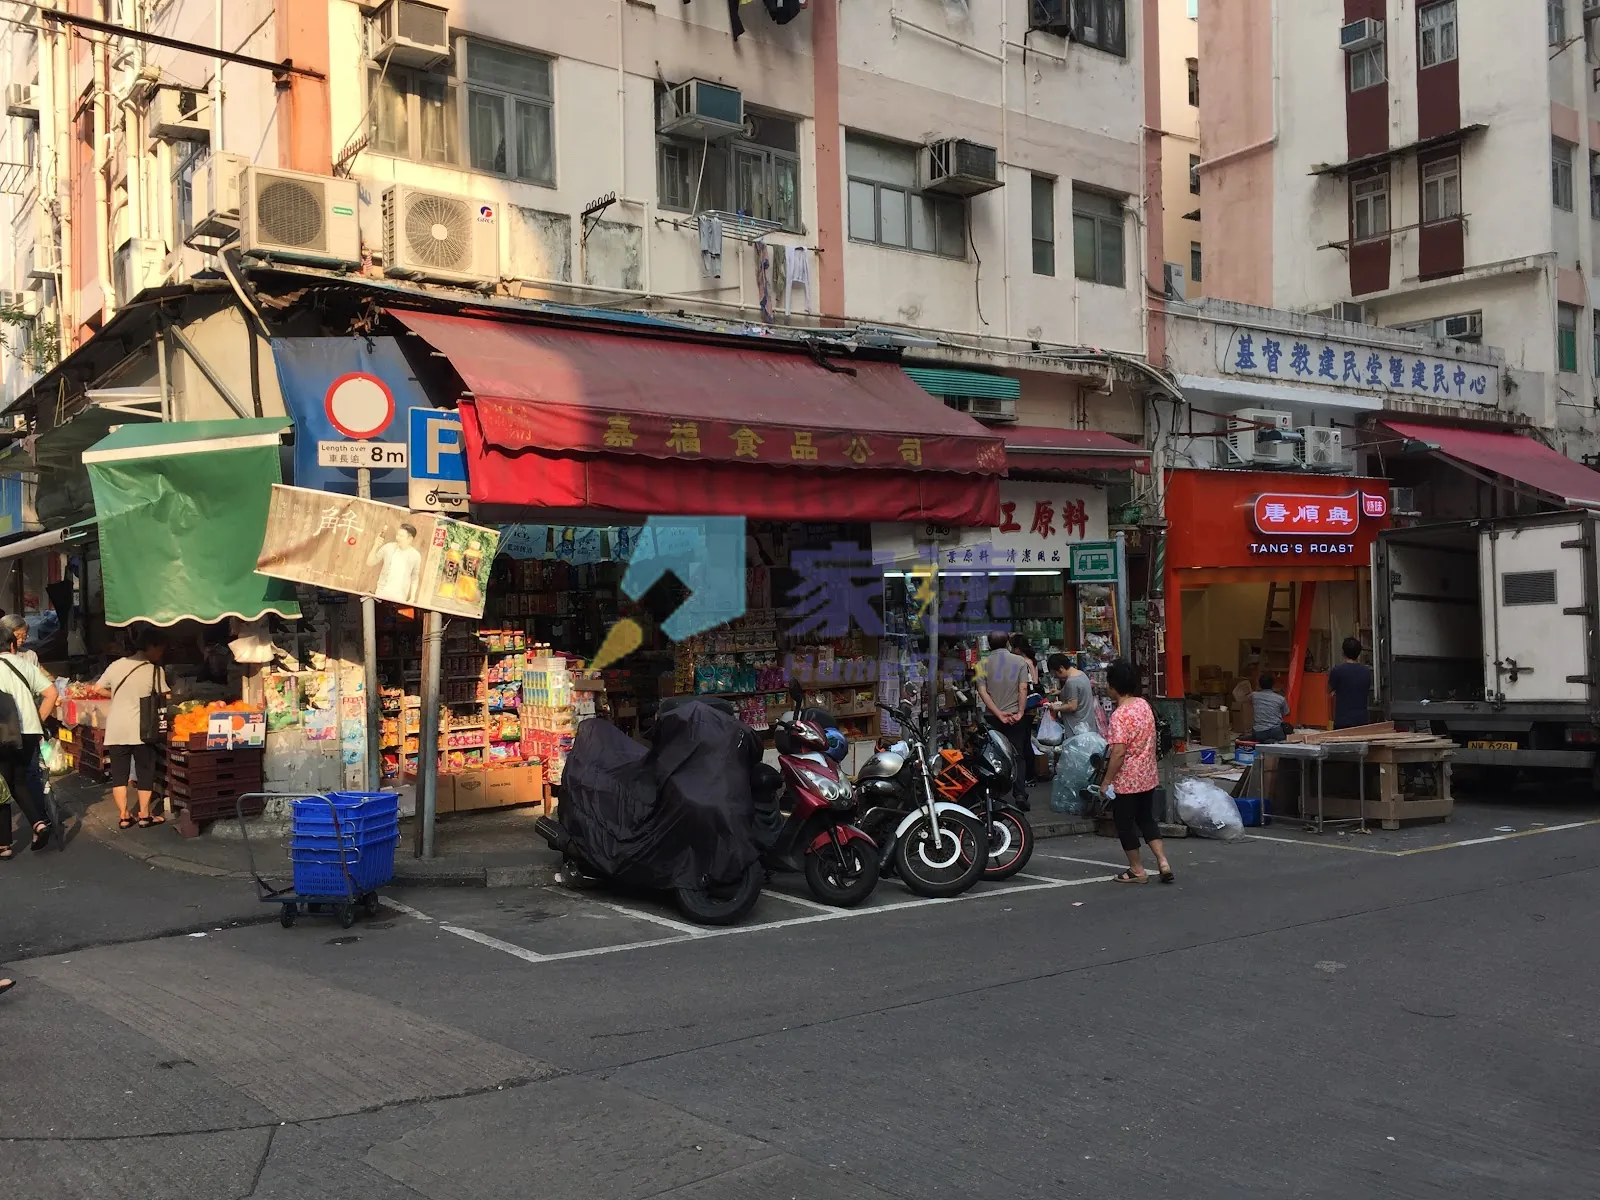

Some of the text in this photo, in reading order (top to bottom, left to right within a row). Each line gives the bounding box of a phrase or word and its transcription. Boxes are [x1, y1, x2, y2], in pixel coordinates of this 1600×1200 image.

[1234, 333, 1487, 397] 基督教建民堂暨建民中心
[321, 444, 348, 453] Length
[426, 417, 467, 474] P
[602, 412, 923, 467] 嘉福食品公司
[328, 453, 360, 464] 車長逾
[1251, 544, 1354, 553] TANG'S ROAST
